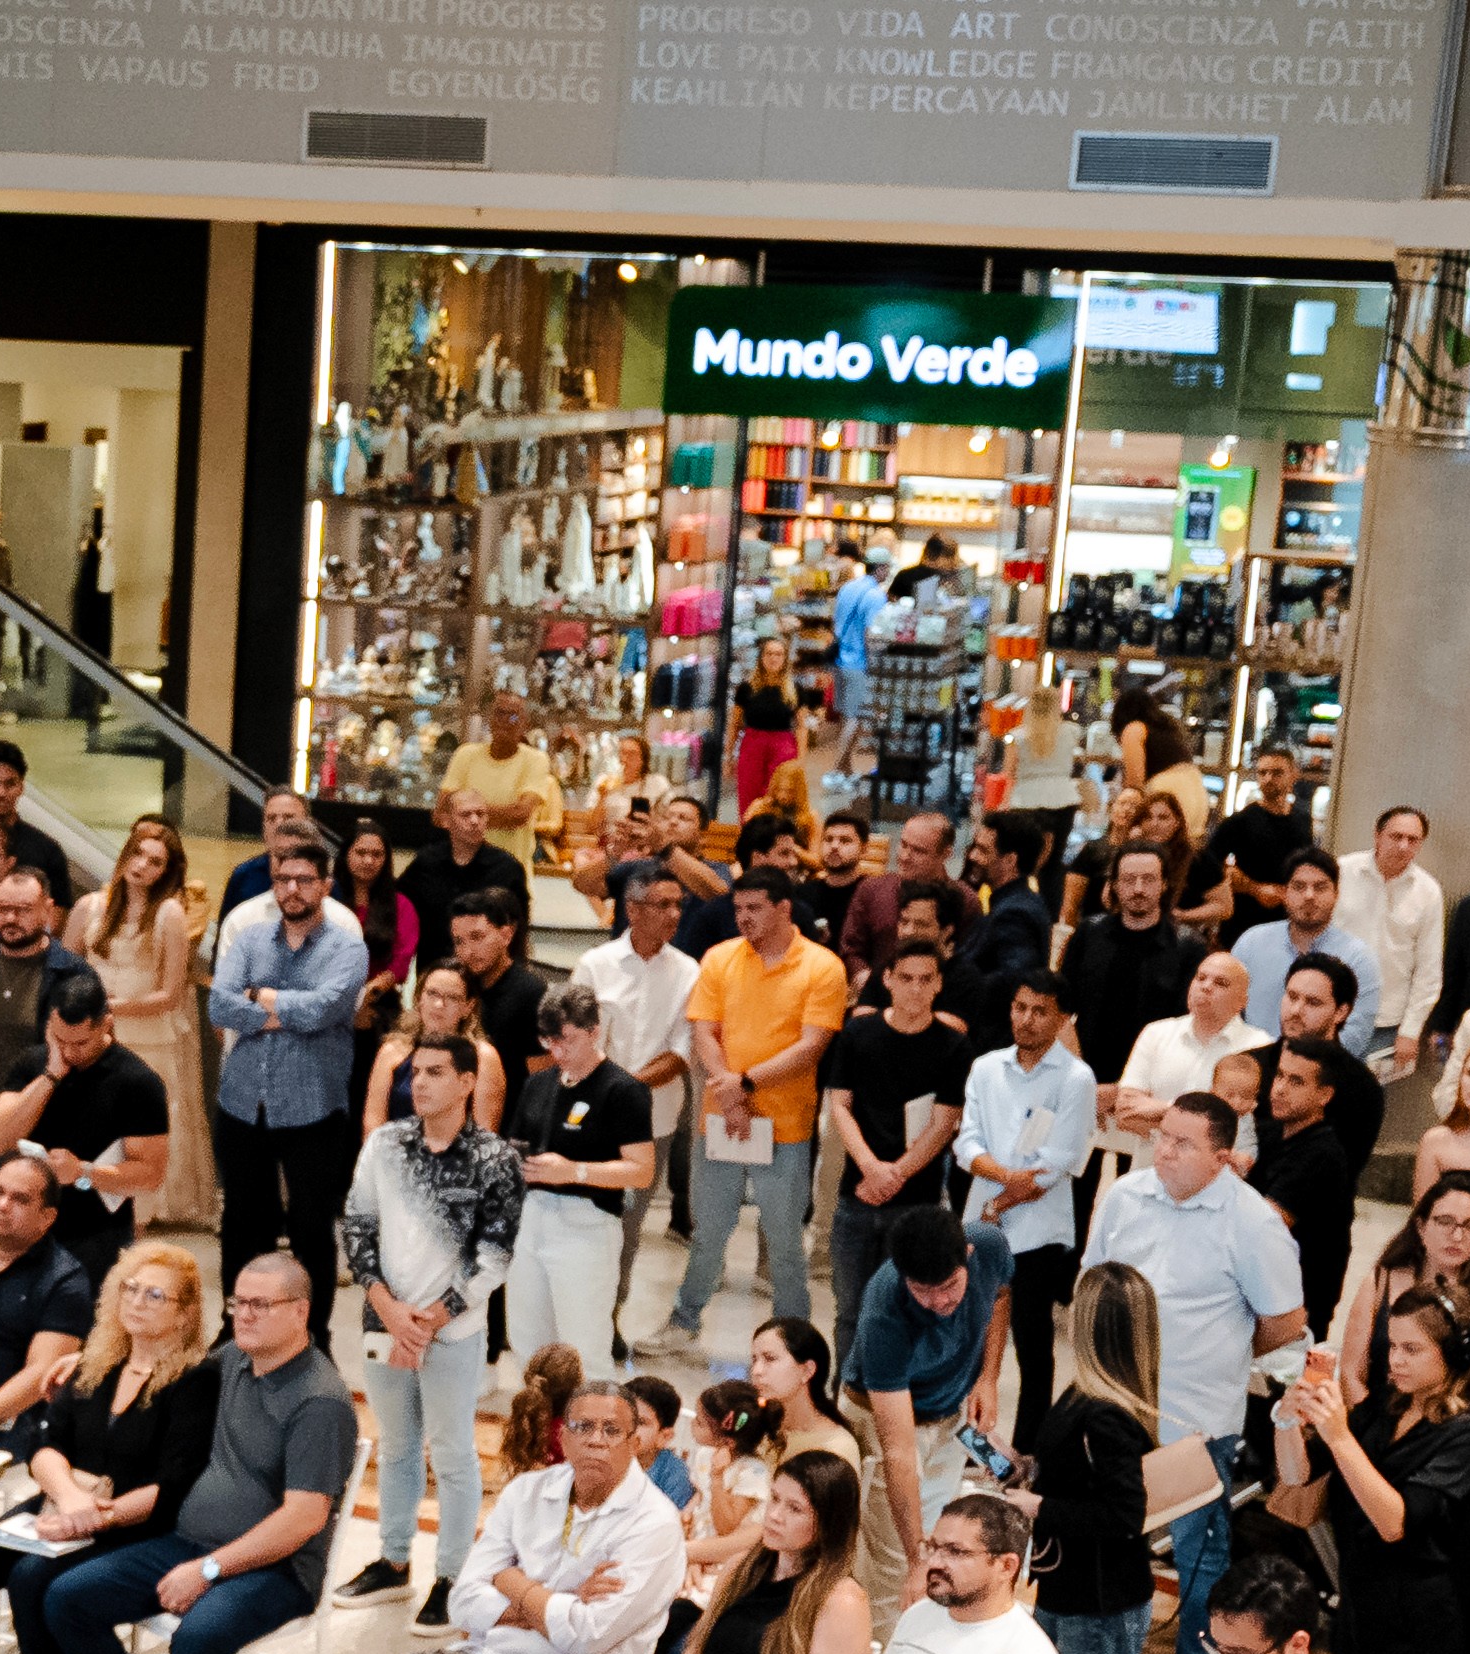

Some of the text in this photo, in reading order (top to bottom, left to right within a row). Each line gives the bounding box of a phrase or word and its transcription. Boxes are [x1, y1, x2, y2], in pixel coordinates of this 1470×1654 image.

[361, 0, 427, 24] MIR
[436, 0, 607, 32] PROGRESS
[638, 4, 1426, 50] PROGRESO VIDA ART CONOSCENZA FAITH
[180, 24, 268, 54] ALAM
[278, 29, 385, 59] RAUHA
[401, 34, 605, 69] IMAGINATIE
[637, 40, 721, 70] LOVE
[737, 43, 824, 73] PAIX
[834, 46, 1038, 80] KNOWLEDGE
[78, 53, 210, 89] VAPAUS
[233, 62, 320, 93] FRED
[630, 76, 805, 109] KEAHLIAN
[823, 83, 1070, 117] KEPERCAYAAN
[1313, 95, 1413, 125] ALAM
[692, 327, 1039, 388] Mundo Verde
